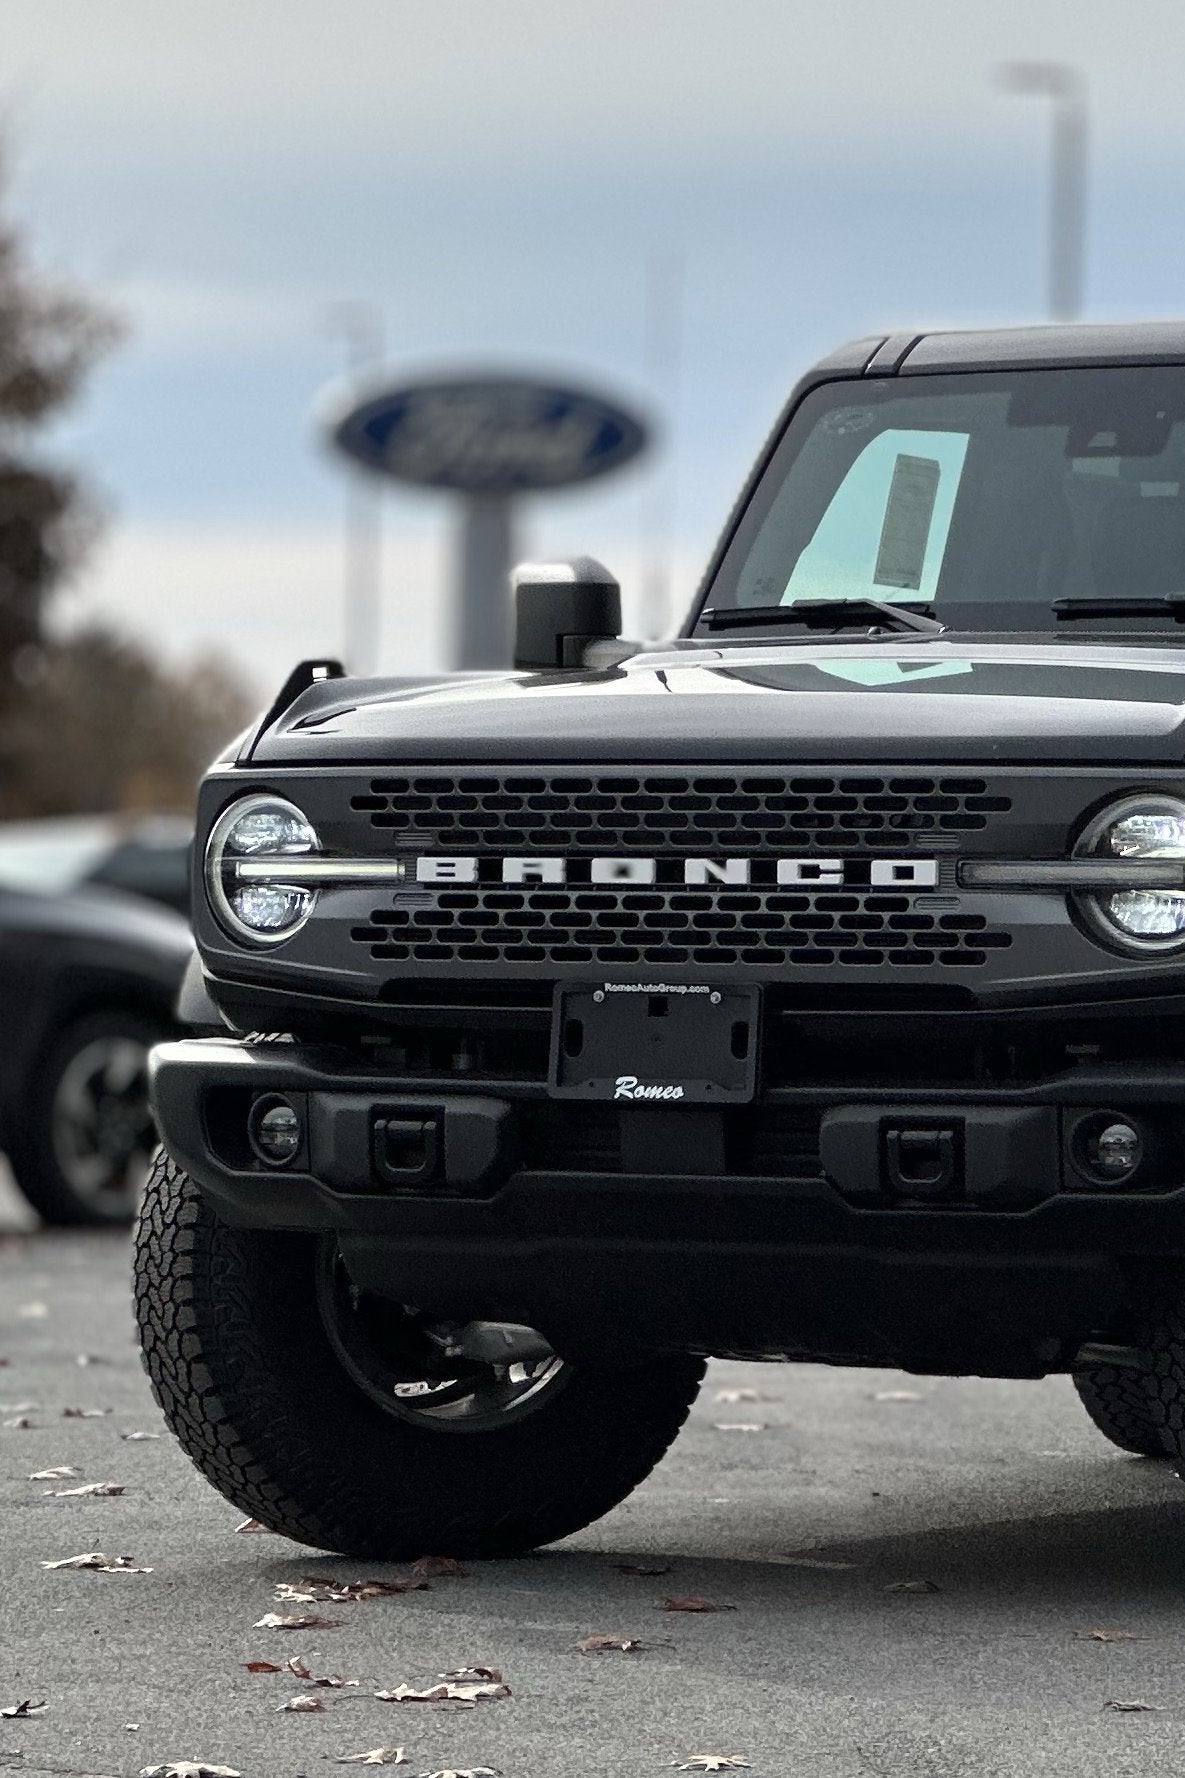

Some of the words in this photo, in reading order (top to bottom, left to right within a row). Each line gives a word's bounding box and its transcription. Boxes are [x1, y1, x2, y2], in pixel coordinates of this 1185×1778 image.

[416, 856, 939, 887] BRONCO
[604, 982, 710, 995] RomeoAutoGroup.com
[613, 1075, 685, 1100] Romeo
